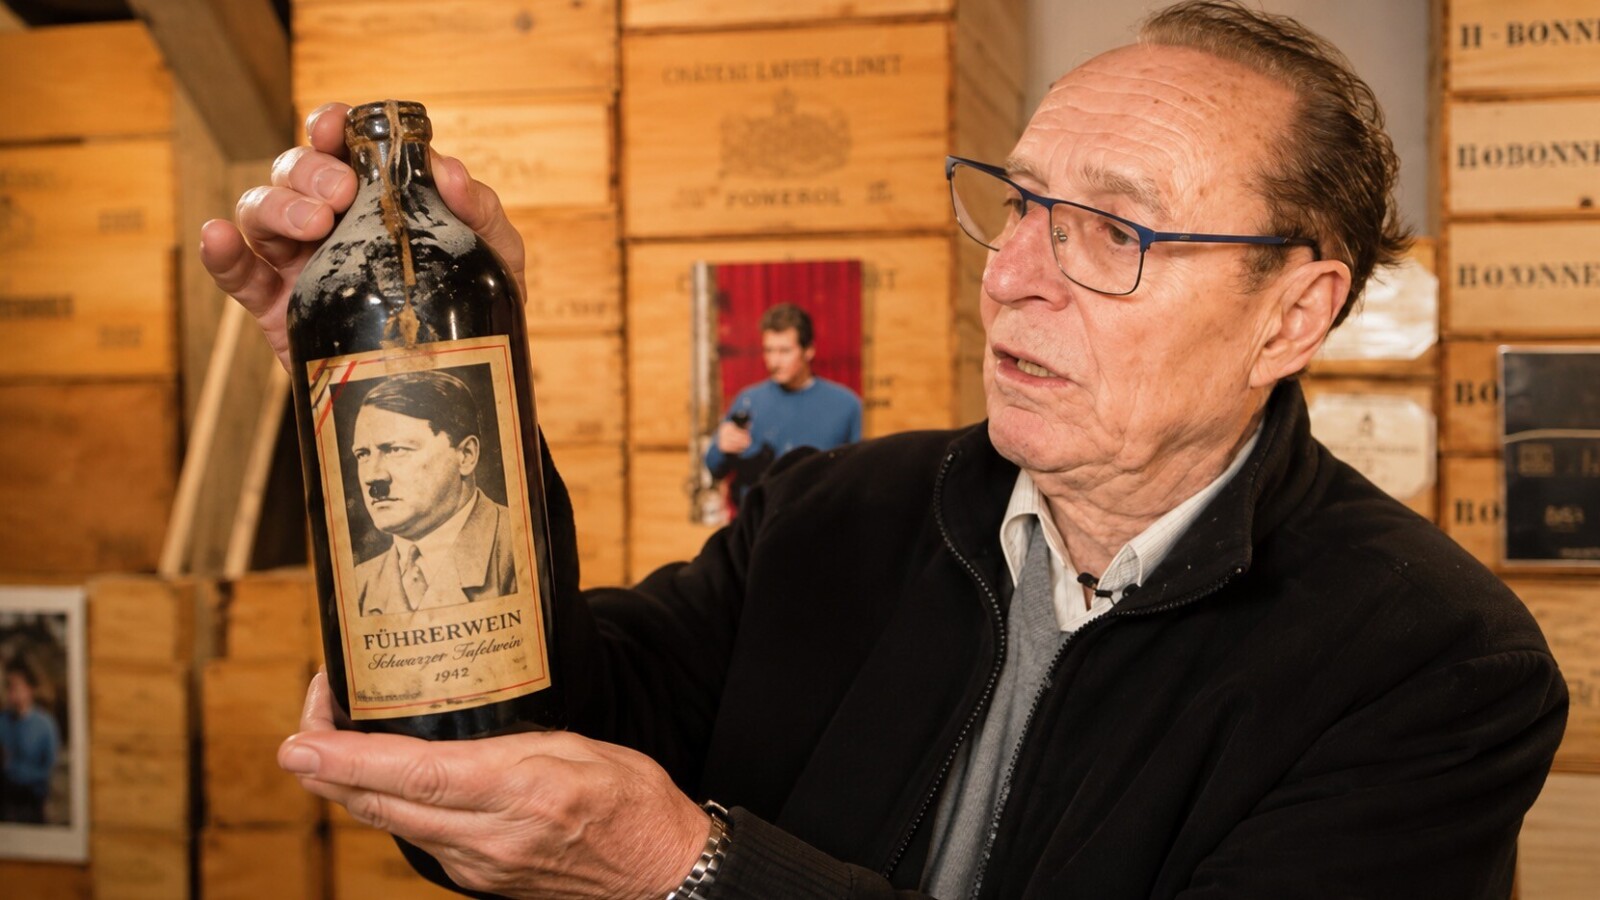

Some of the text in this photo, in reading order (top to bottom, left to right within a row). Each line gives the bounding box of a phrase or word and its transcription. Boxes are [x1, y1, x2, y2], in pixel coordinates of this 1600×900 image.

[1506, 18, 1600, 47] BONN
[363, 609, 522, 650] FÜHRERWEIN
[367, 652, 448, 671] Schwarzer
[452, 635, 524, 663] Tafelwein
[434, 667, 470, 683] 1942
